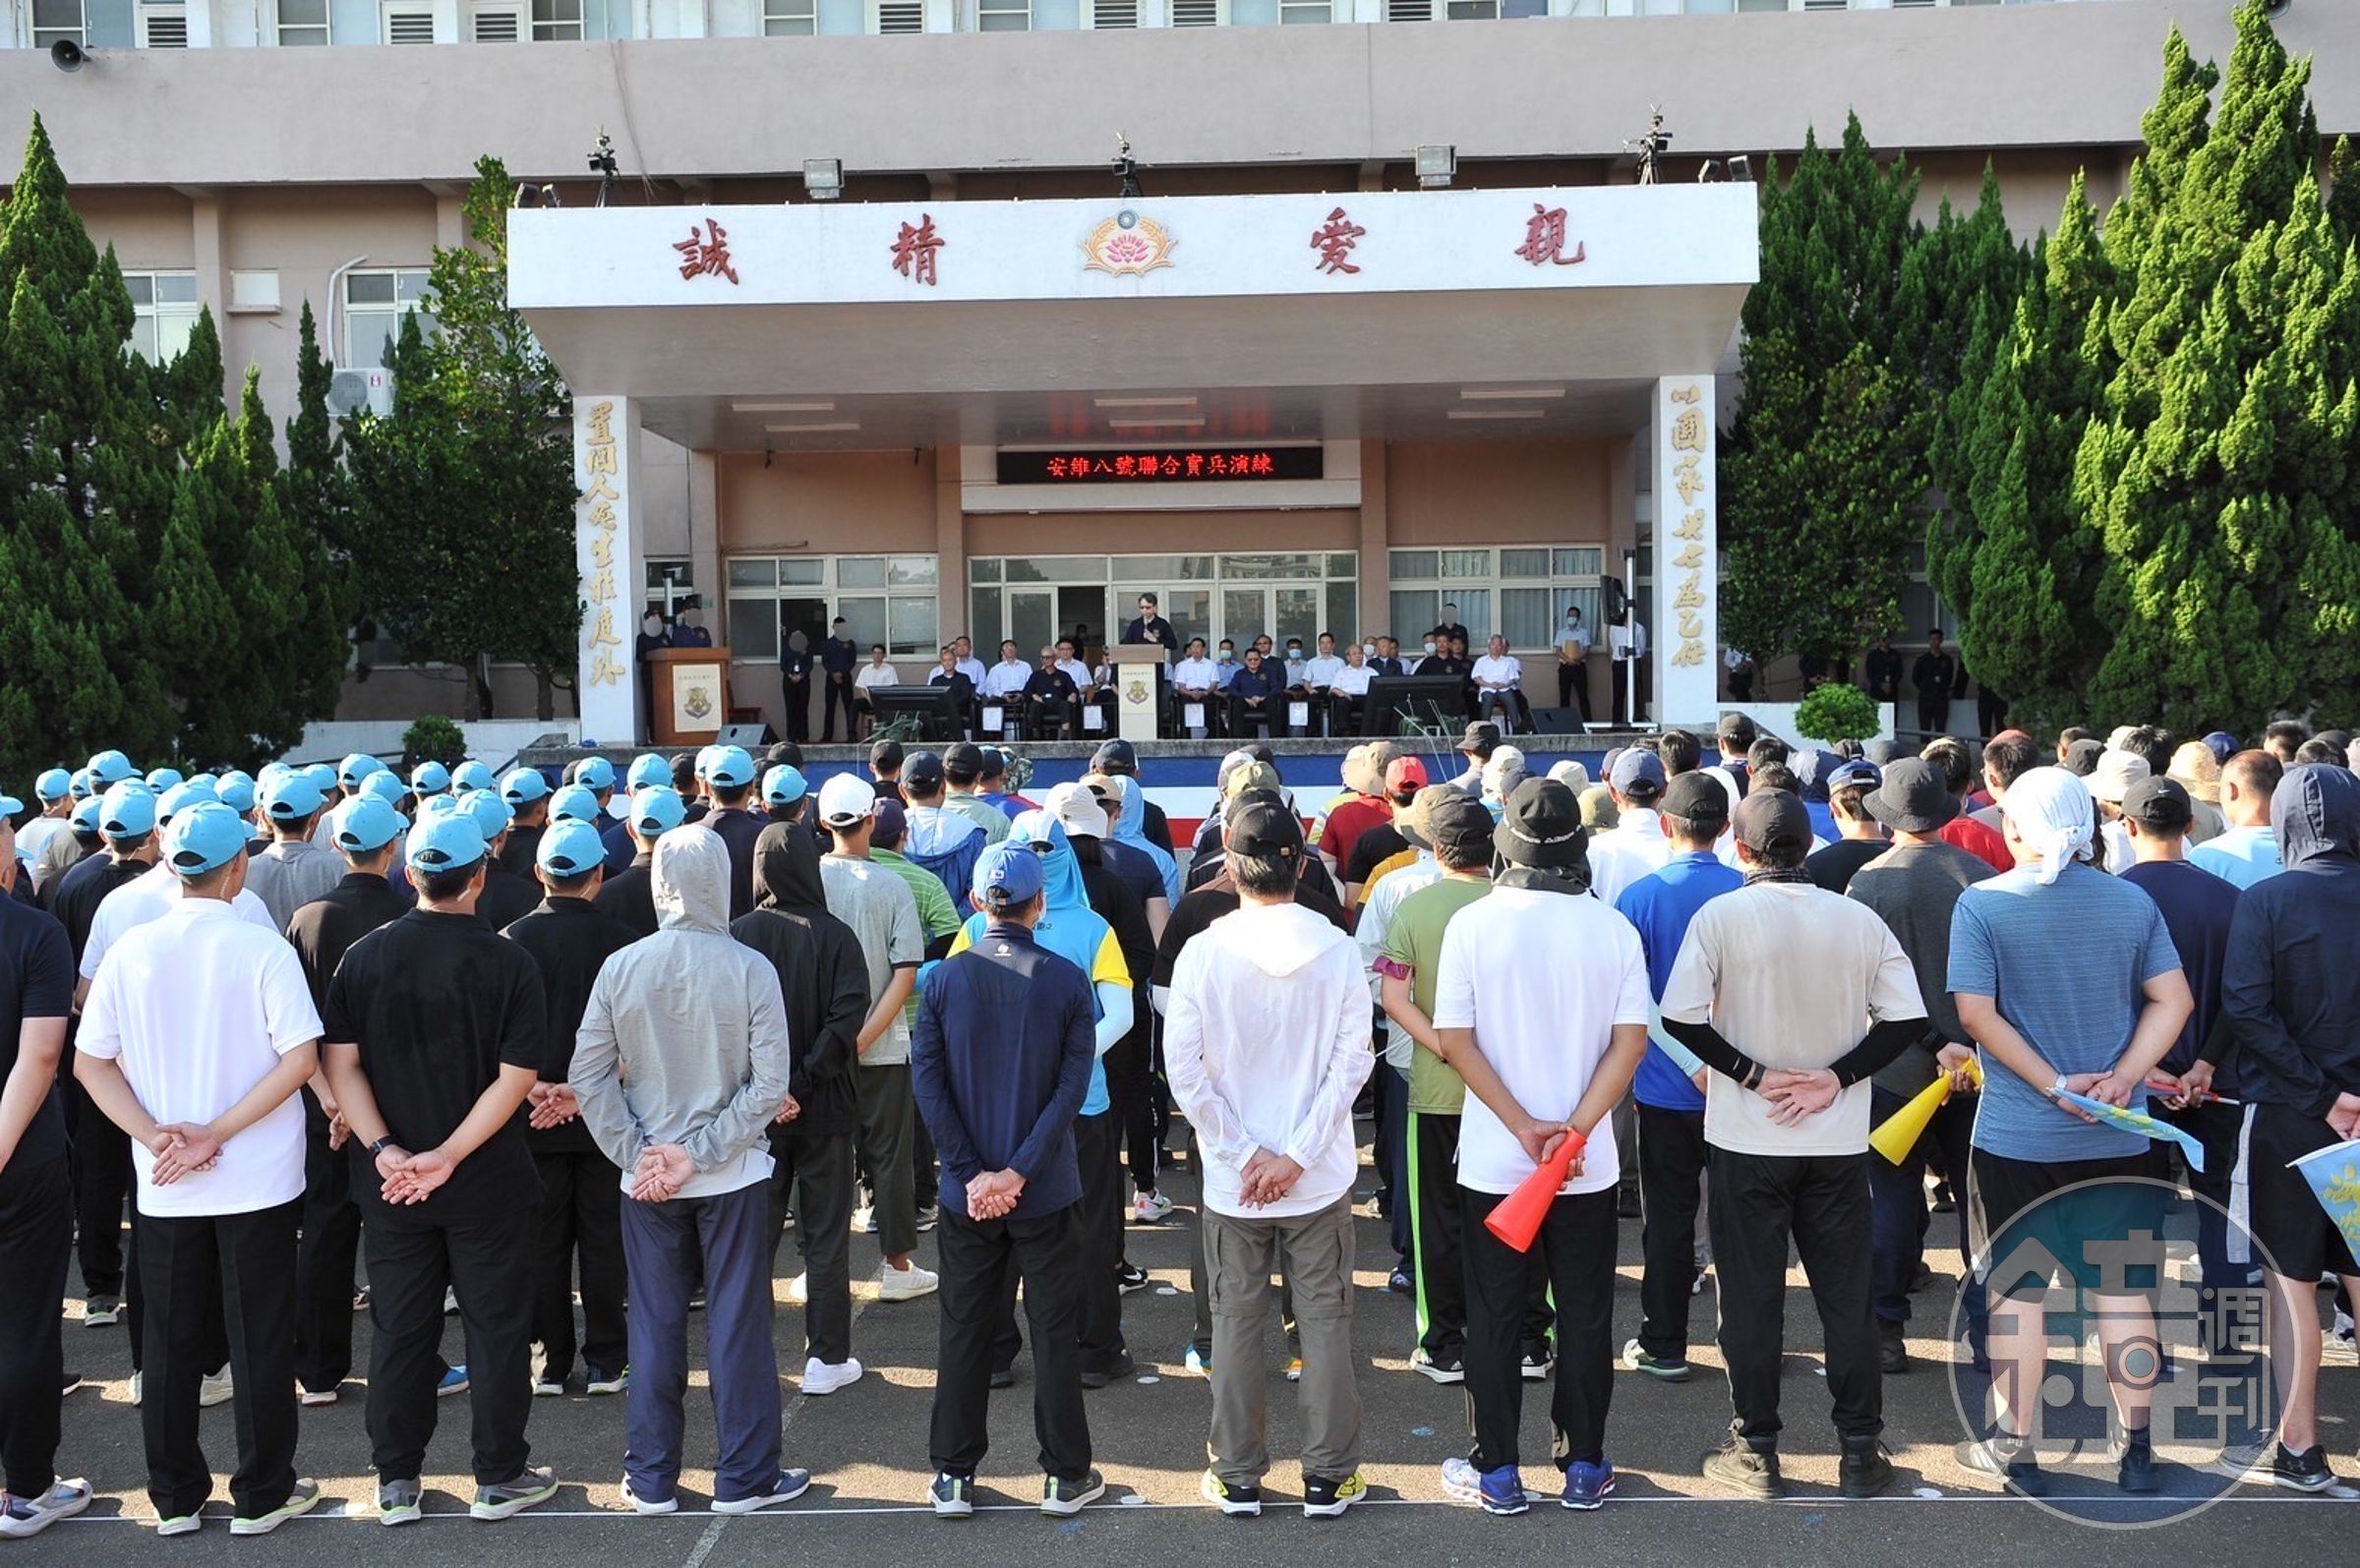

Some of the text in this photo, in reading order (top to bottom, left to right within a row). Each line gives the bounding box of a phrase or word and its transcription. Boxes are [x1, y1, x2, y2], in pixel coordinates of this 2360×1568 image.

[1046, 453, 1273, 478] 安維八號聯合實兵演練
